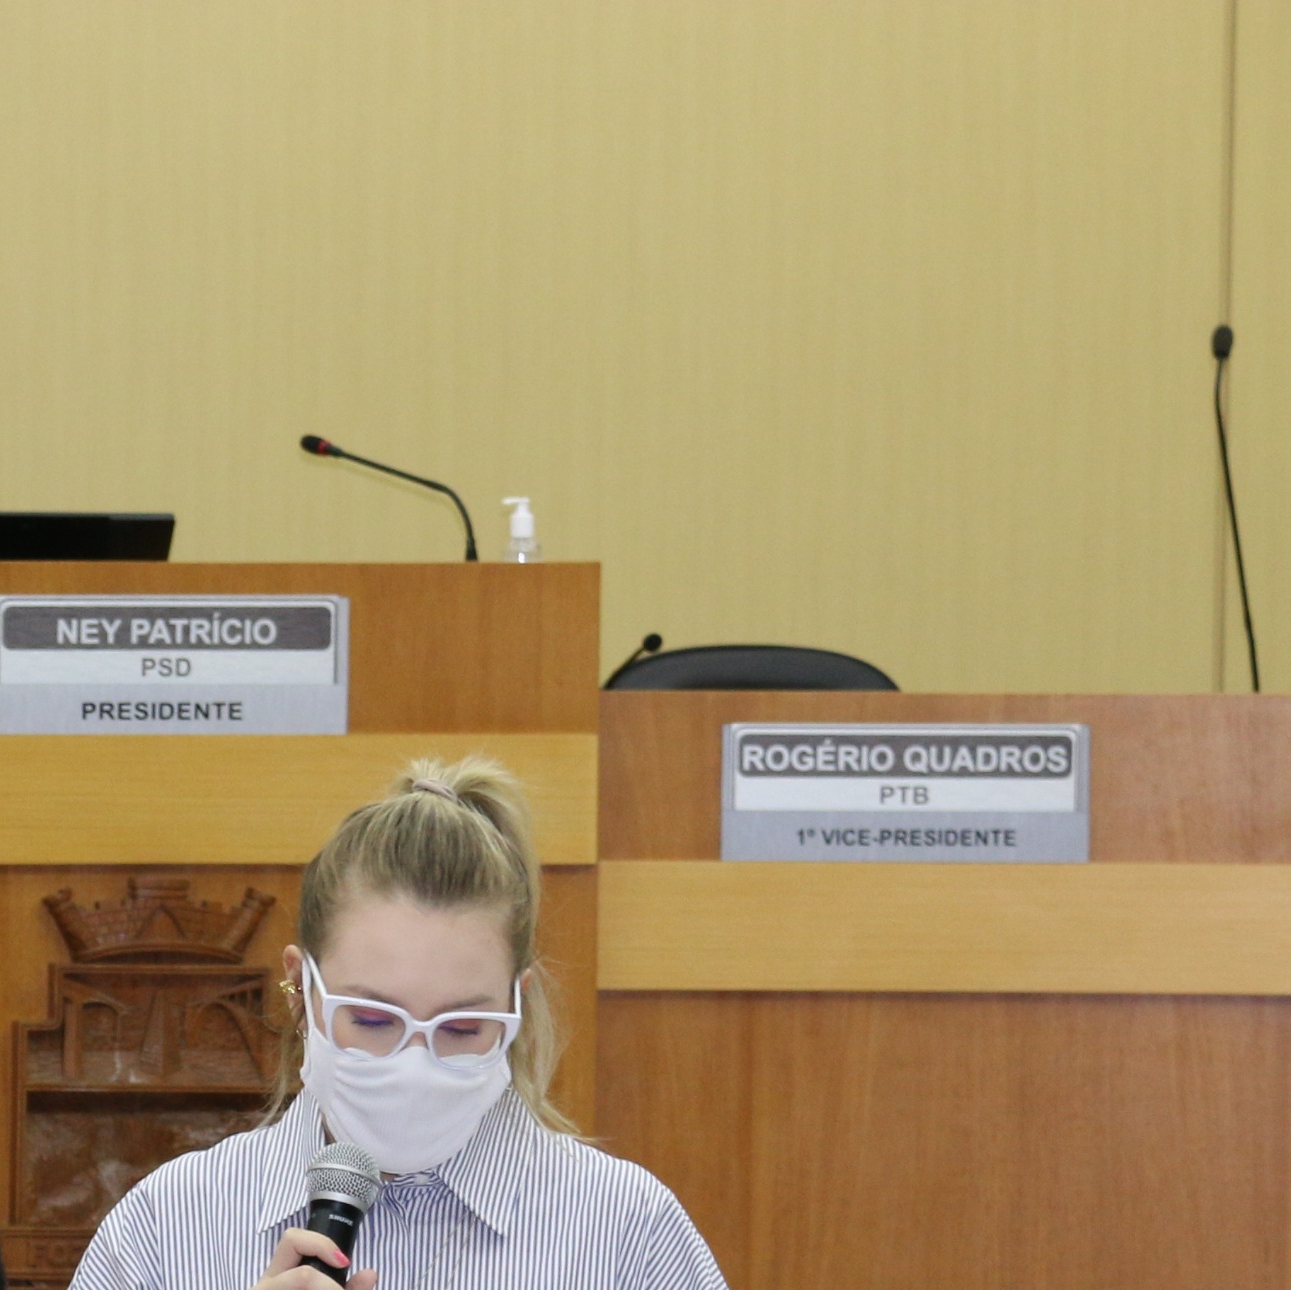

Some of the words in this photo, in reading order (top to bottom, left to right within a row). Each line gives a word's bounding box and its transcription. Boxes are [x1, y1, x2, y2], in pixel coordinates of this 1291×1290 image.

[56, 618, 122, 645] NEY
[130, 610, 277, 646] PATRÍCIO
[141, 657, 192, 678] PSD
[81, 702, 243, 721] PRESIDENTE
[742, 739, 895, 773] ROGÉRIO
[903, 744, 1069, 775] QUADROS
[879, 785, 930, 806] PTB
[821, 828, 1017, 848] VICE-PRESIDENTE
